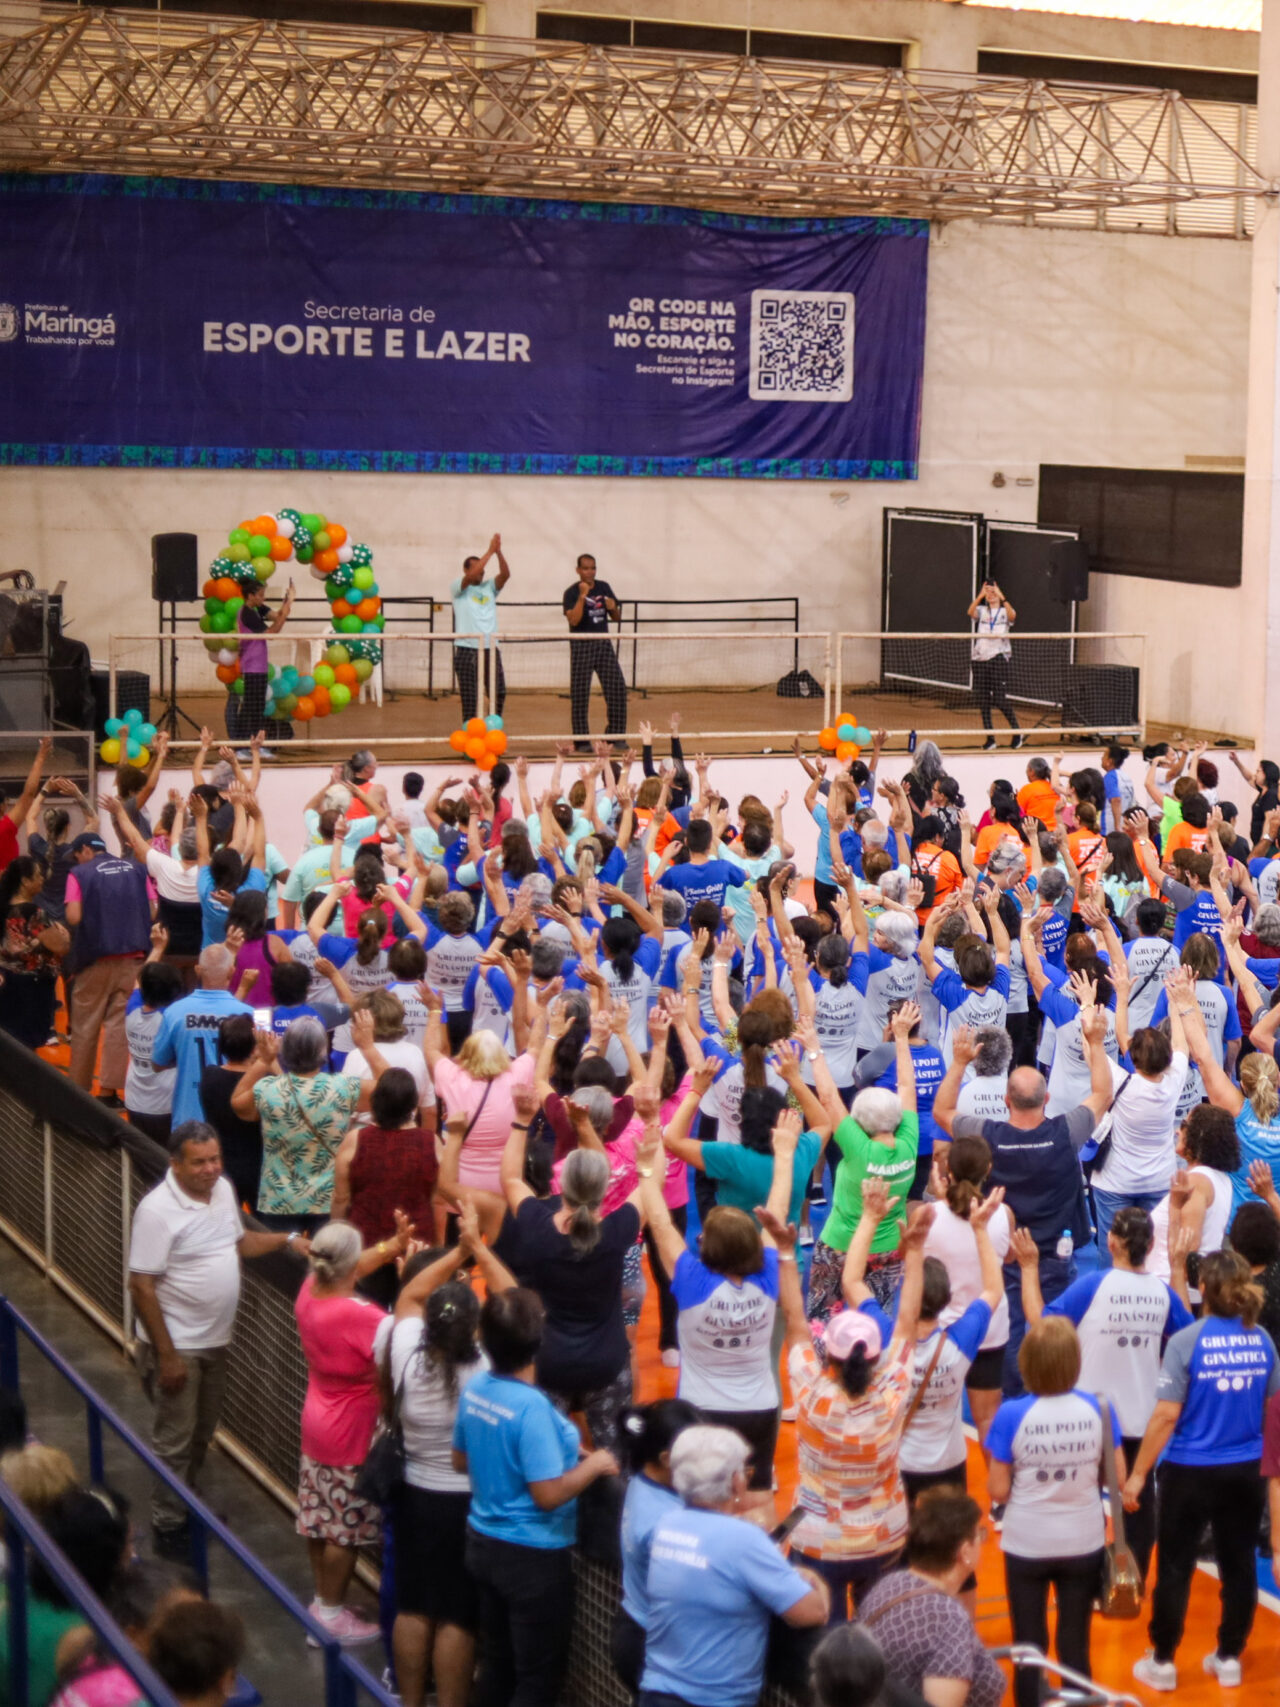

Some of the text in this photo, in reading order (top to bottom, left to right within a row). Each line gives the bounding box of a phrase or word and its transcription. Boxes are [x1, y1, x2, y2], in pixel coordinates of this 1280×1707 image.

[25, 303, 69, 312] Prefeitura de
[303, 300, 436, 323] Secretaria de
[629, 298, 736, 316] QR CODE NA
[24, 311, 116, 338] Maringá
[608, 312, 736, 334] MÃO, ESPORTE
[25, 335, 115, 346] Trabalhando por você
[203, 321, 531, 362] ESPORTE E LAZER
[614, 332, 736, 354] NO CORAÇÃO.
[657, 355, 735, 368] Escaneie e siga a
[635, 363, 735, 378] Secretaria de Esporte
[671, 375, 735, 387] no Instagram!
[1198, 901, 1218, 910] GRUP
[974, 1106, 1008, 1116] GINÁST
[709, 1299, 748, 1312] GRUPO
[1109, 1295, 1153, 1305] GRUPO
[1201, 1335, 1263, 1348] GRUPO DE
[1203, 1350, 1267, 1366] GINÁSTICA
[1024, 1420, 1094, 1436] GRUPO DE
[1025, 1440, 1096, 1455] GINÁSTICA
